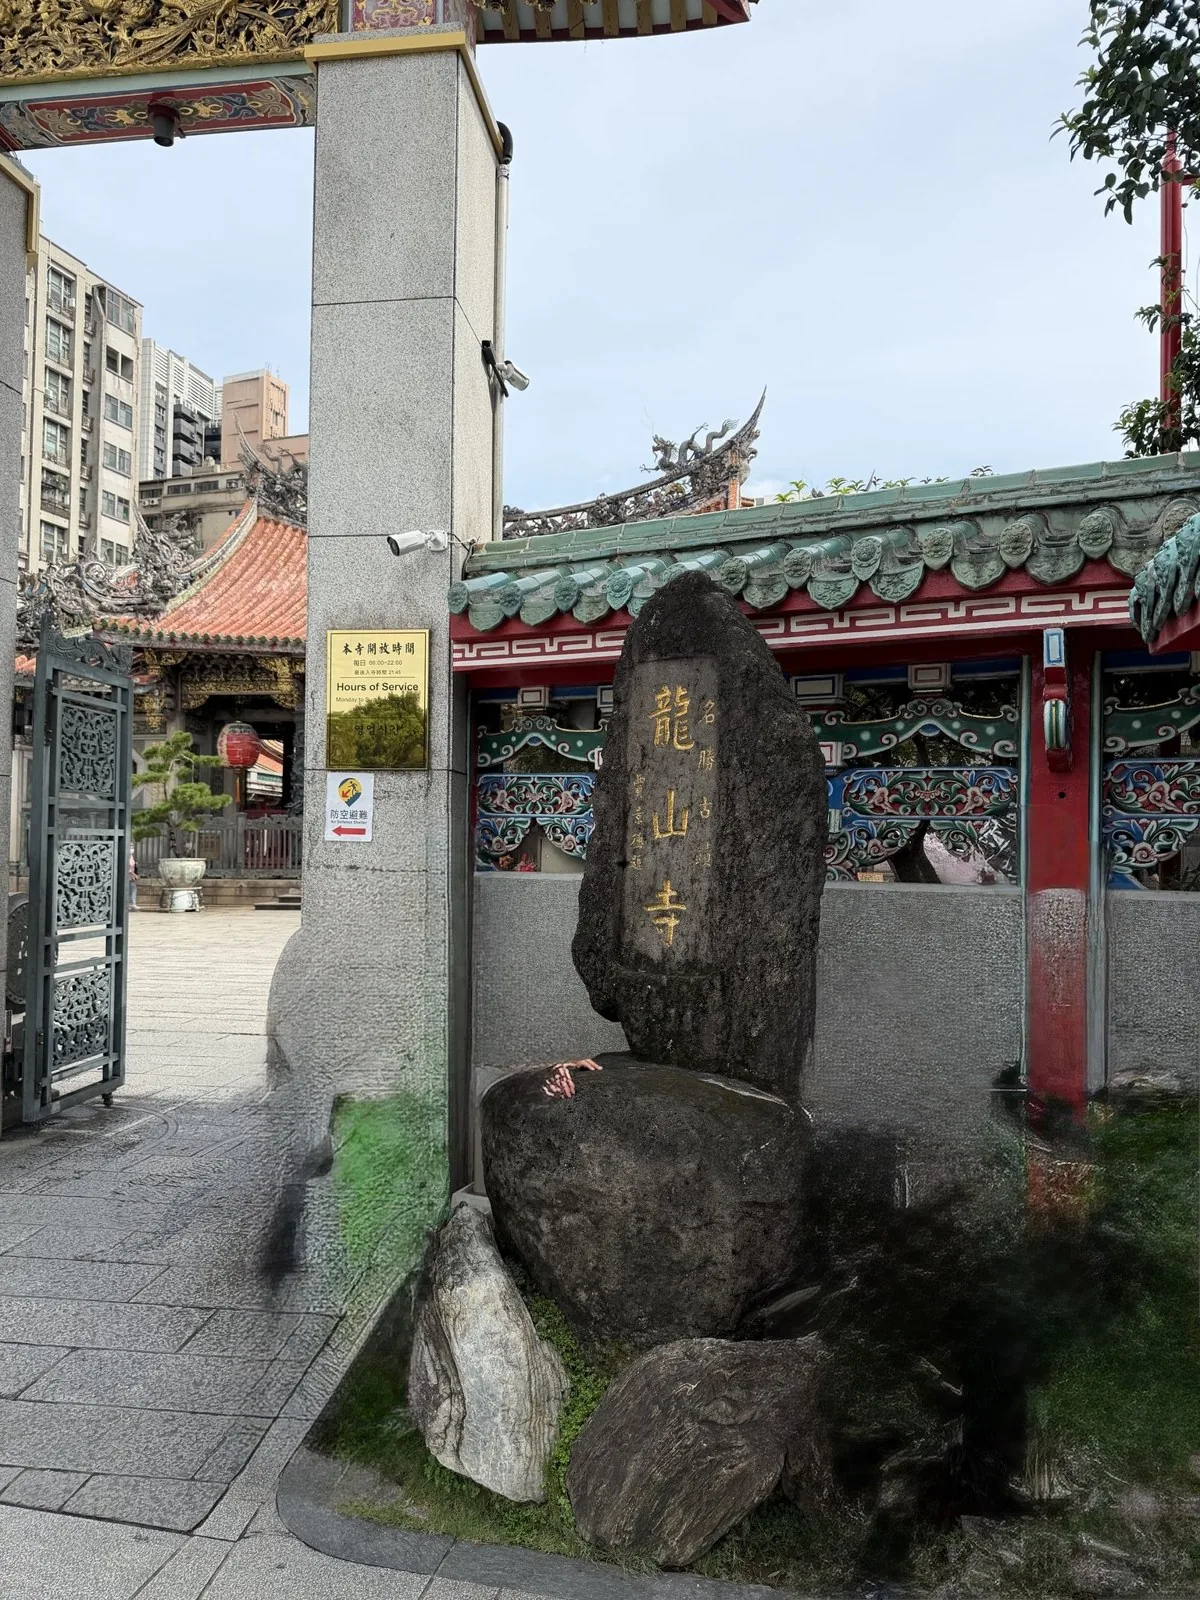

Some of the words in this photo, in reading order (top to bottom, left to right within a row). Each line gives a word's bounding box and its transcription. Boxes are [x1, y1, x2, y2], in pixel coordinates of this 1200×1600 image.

[342, 642, 415, 656] 本寺開放時間
[336, 683, 367, 691] Hours
[369, 682, 380, 691] of
[382, 682, 419, 691] Service
[354, 723, 399, 736] 영업시간
[330, 809, 368, 820] 防空避難
[643, 683, 695, 947] 龍山寺
